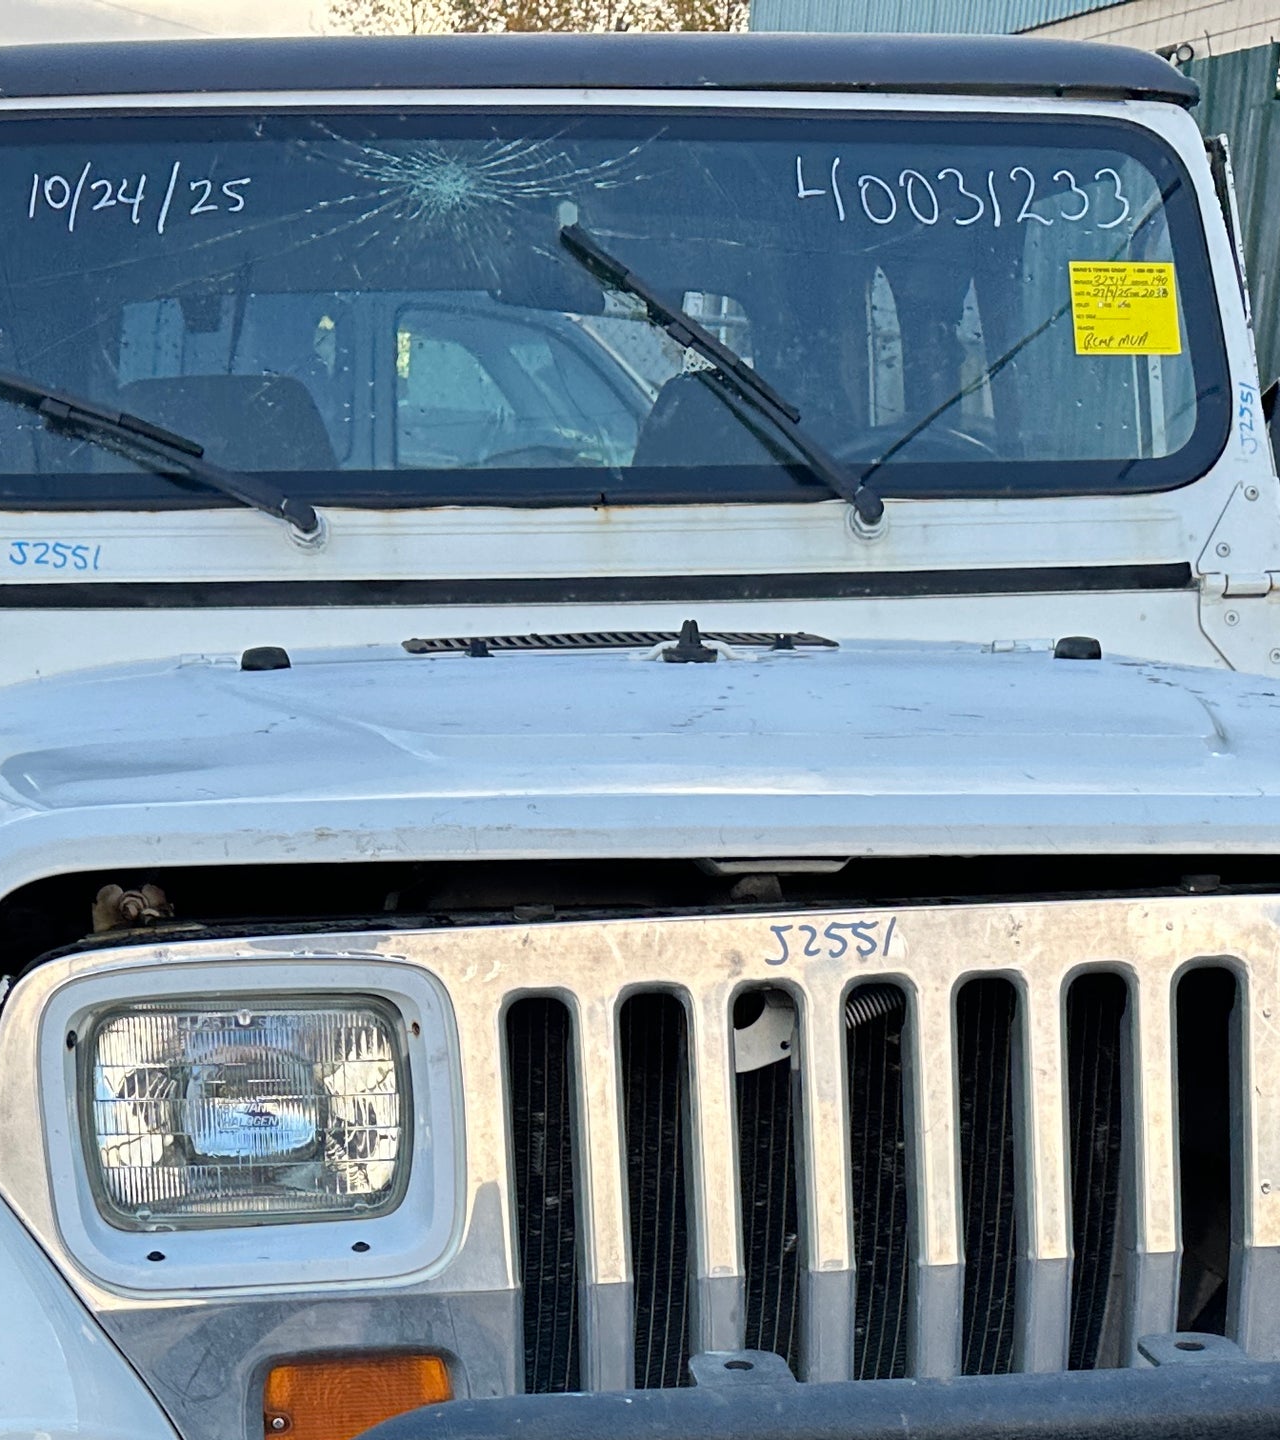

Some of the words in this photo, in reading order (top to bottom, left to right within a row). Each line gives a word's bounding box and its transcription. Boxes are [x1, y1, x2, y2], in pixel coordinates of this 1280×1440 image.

[28, 161, 252, 235] 10/24/25
[796, 155, 1130, 229] 40031233
[9, 541, 101, 571] J2551
[764, 916, 897, 966] J2551
